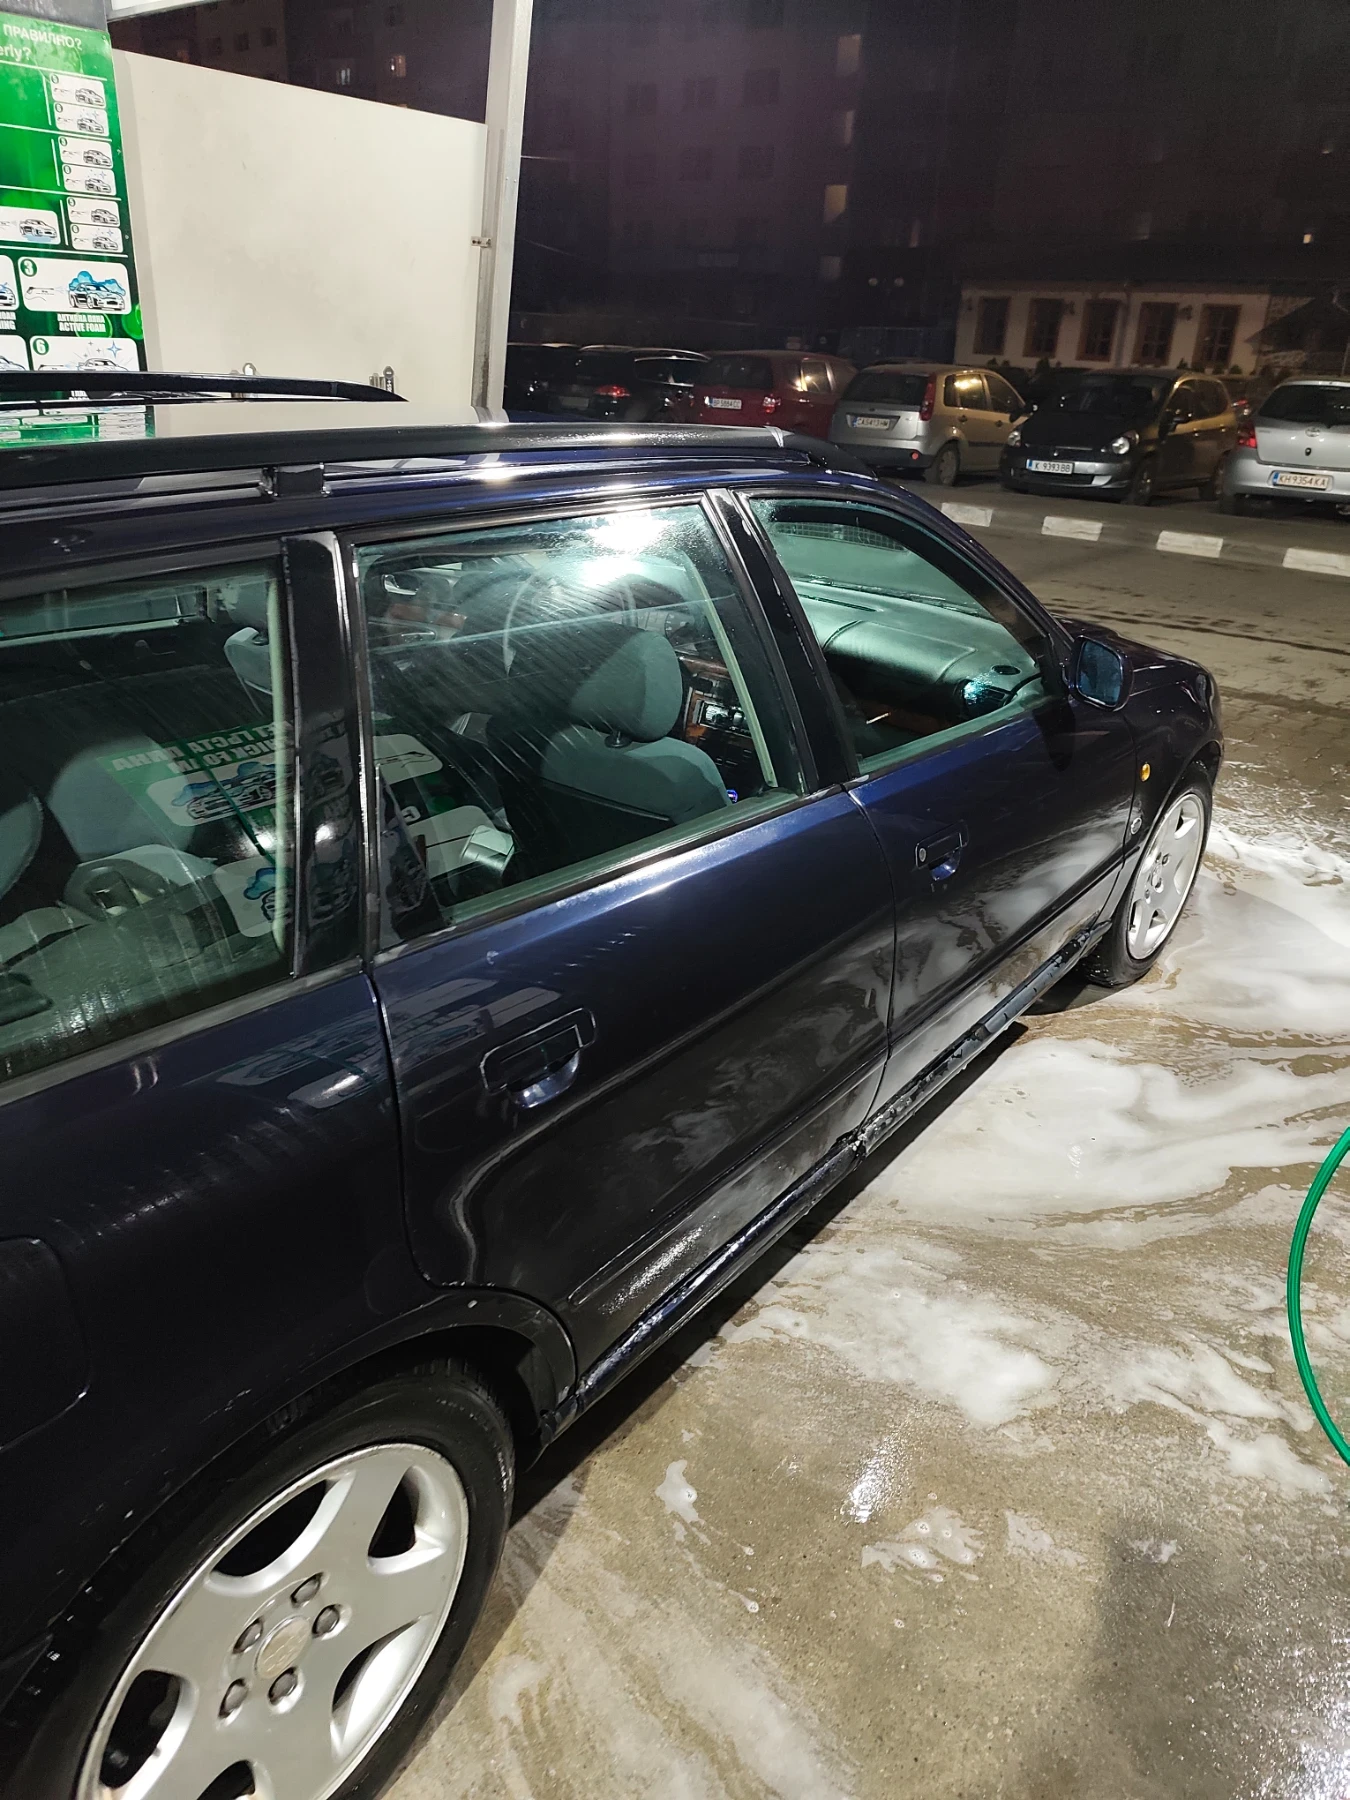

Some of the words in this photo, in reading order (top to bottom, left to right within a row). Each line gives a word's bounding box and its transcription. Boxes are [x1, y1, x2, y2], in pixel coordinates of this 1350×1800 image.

[3, 23, 82, 51] ПРАВИЛНО?
[24, 261, 34, 275] 3
[59, 322, 85, 332] ACTIVE
[85, 323, 106, 333] FOAM
[36, 340, 47, 354] 6
